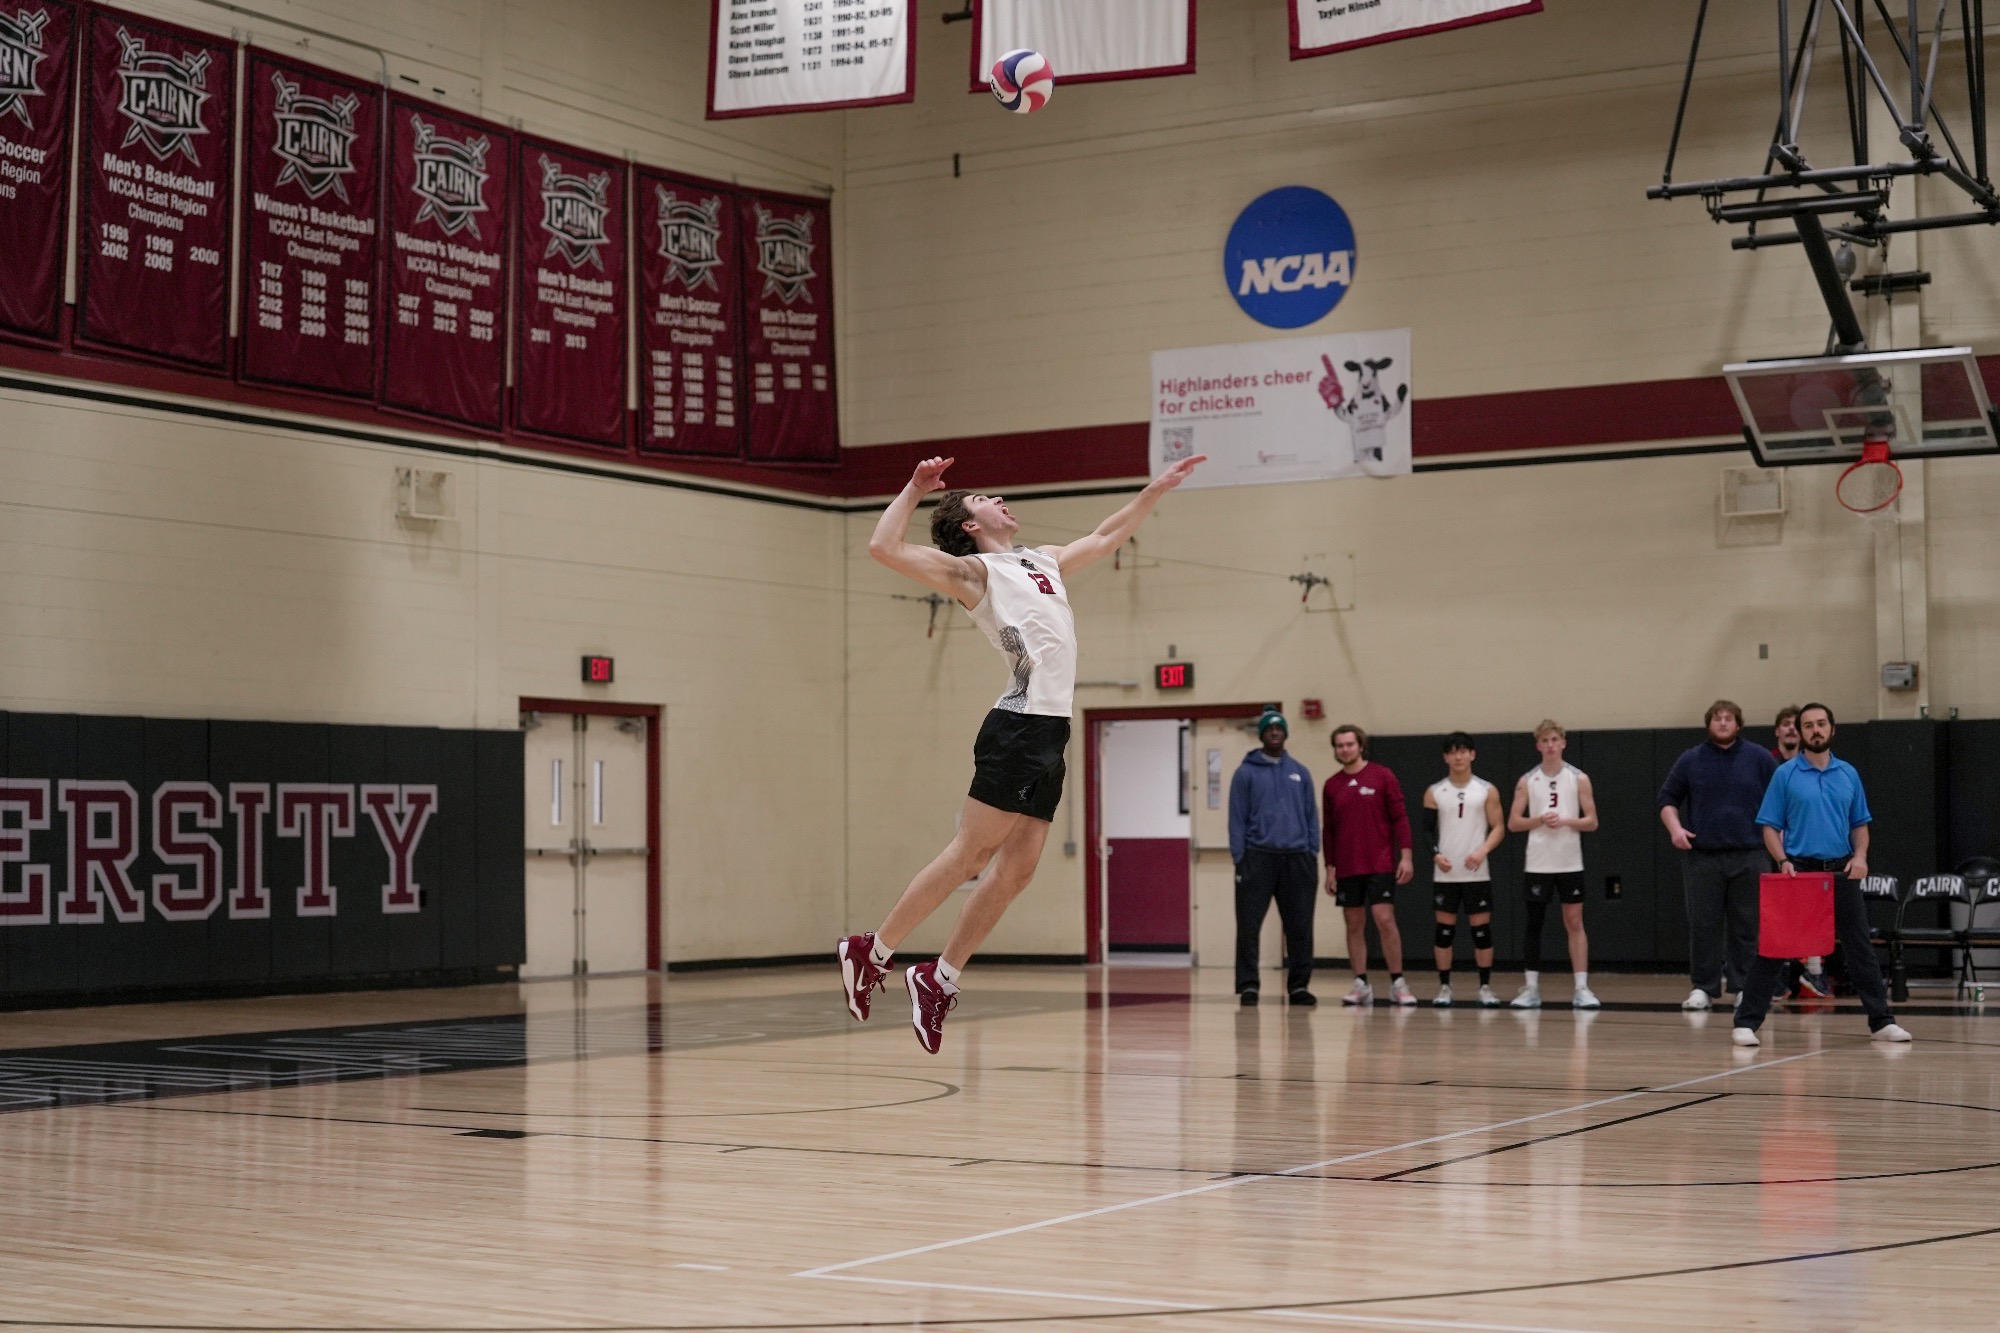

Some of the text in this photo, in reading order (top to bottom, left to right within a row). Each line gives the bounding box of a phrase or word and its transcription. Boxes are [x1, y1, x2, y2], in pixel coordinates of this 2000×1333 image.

[1318, 7, 1346, 19] Taylor
[130, 81, 194, 128] CAIRN
[284, 120, 343, 165] CAIRN
[1, 159, 41, 185] Region
[102, 151, 215, 198] Men's Basketball
[422, 160, 476, 205] CAIRN
[108, 176, 208, 217] NCCAA East Region
[128, 202, 184, 232] Champions
[254, 192, 375, 236] Women's Basketball
[551, 198, 599, 238] CAIRN
[145, 233, 174, 255] 1999
[190, 245, 220, 266] 2000
[268, 217, 360, 252] NCCAA East Region
[667, 225, 712, 260] CAIRN
[101, 240, 173, 272] 2002 2005
[287, 240, 342, 266] Champions
[764, 241, 807, 273] CAIRN
[1238, 250, 1350, 296] NCAA
[1159, 369, 1313, 397] Highlanders cheer
[1159, 394, 1256, 415] for chicken
[1160, 664, 1186, 688] EXIT
[1458, 802, 1464, 819] 1
[1548, 792, 1558, 808] 3
[0, 777, 438, 926] ERSITY
[1860, 876, 1892, 896] AIRN
[1916, 877, 1961, 897] CAIRN
[1986, 877, 2000, 897] C
